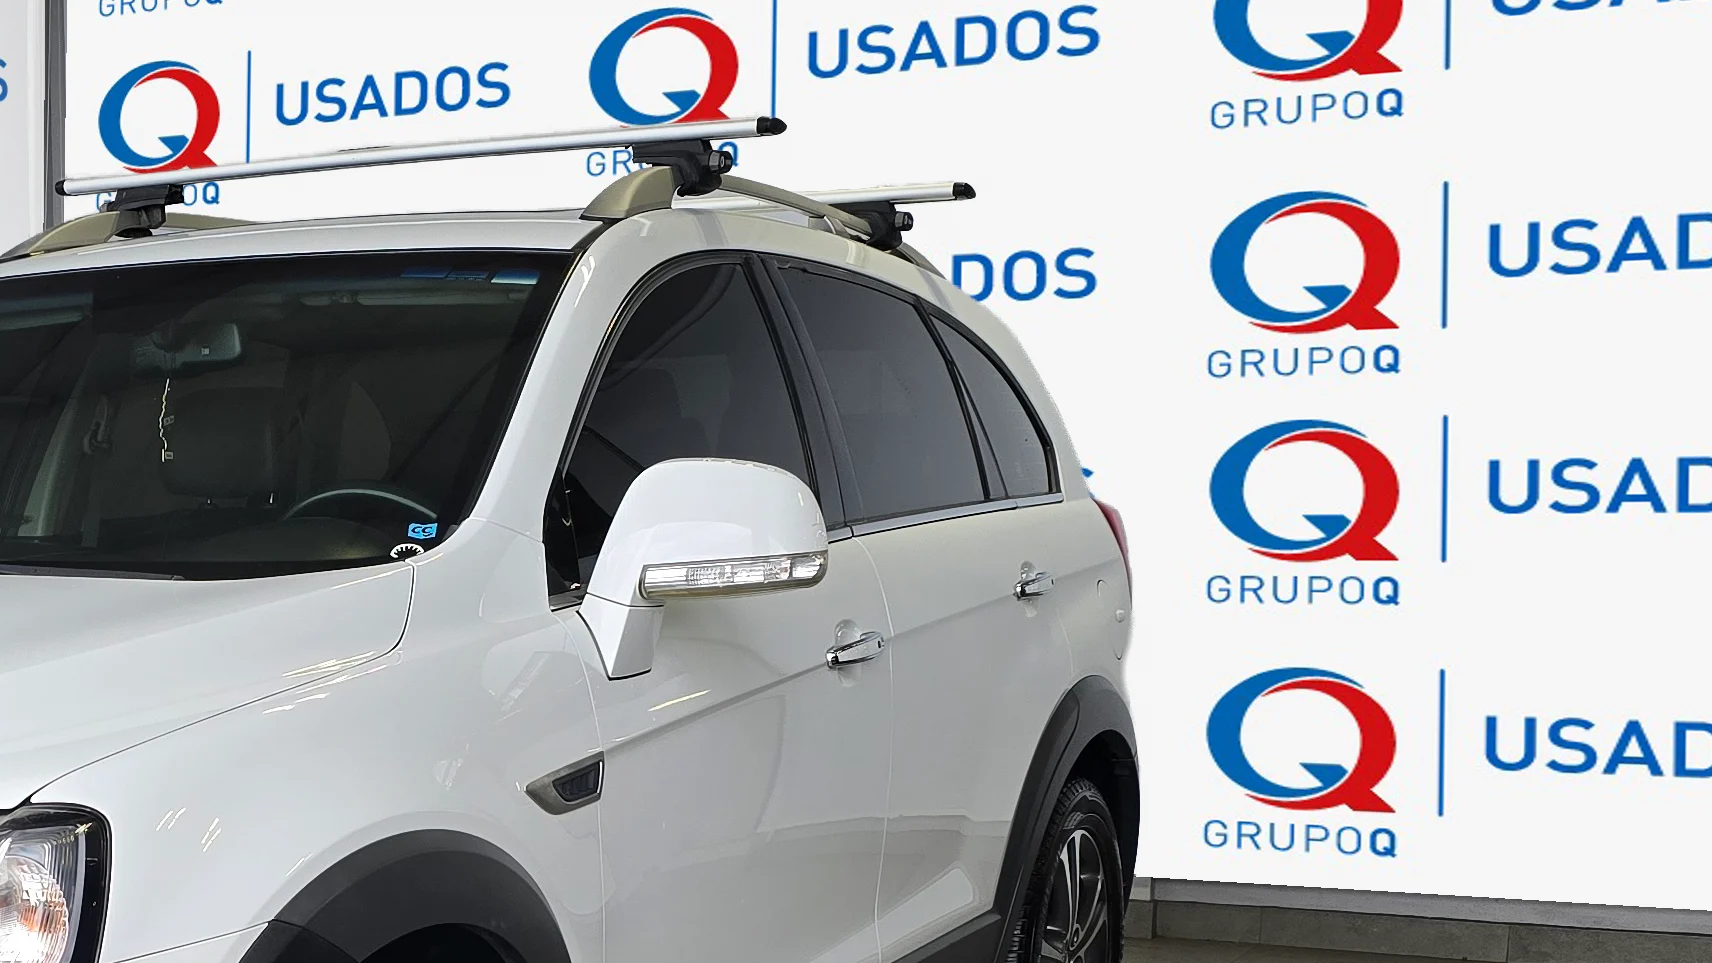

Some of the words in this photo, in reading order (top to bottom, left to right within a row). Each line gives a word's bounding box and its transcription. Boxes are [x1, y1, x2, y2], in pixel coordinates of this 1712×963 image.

[808, 4, 1101, 79] USADOS
[276, 62, 511, 126] USADOS
[1211, 88, 1403, 129] GRUPOQ
[1488, 212, 1712, 278] USAD
[952, 247, 1098, 302] DOS
[1208, 344, 1400, 378] GRUPOQ
[1488, 456, 1712, 514] USAD
[1206, 575, 1400, 605] GRUPOQ
[1485, 715, 1712, 779] USAD
[1203, 820, 1397, 858] GRUPOQ
